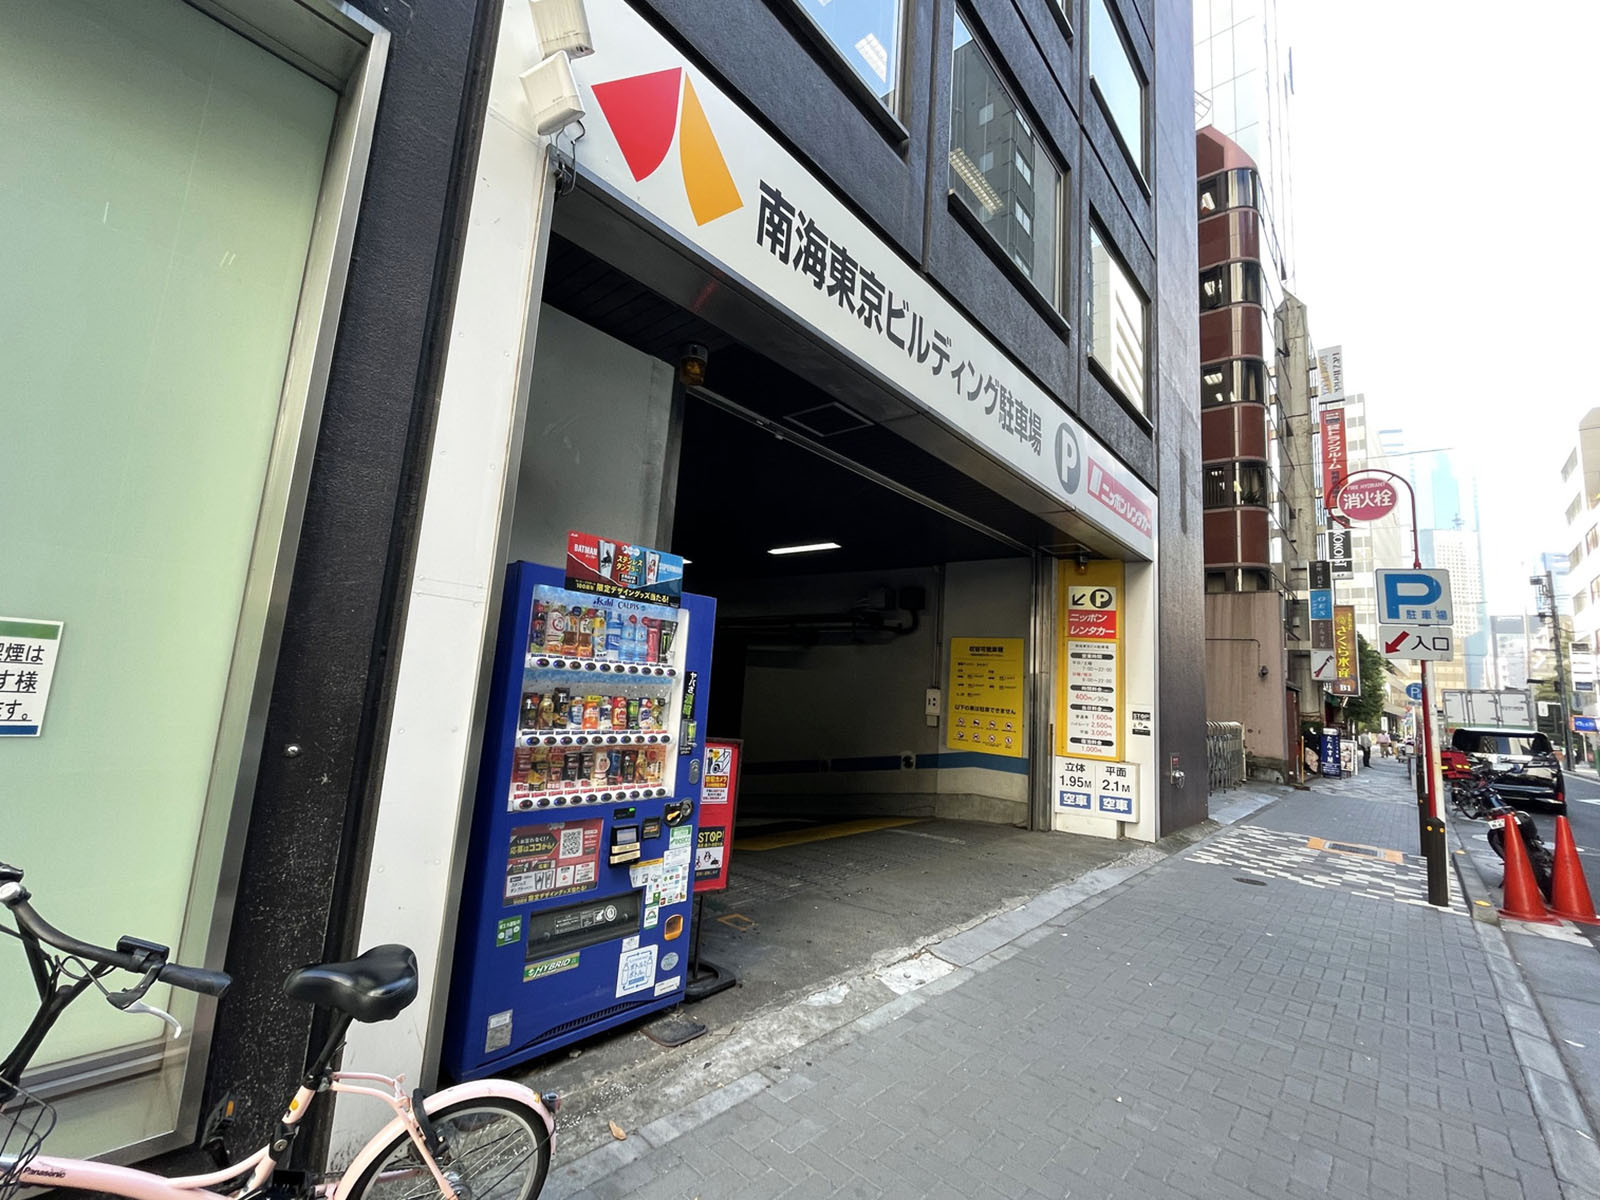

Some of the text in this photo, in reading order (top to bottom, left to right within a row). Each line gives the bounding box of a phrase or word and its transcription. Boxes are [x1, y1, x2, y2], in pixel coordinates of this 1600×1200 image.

[756, 178, 1042, 456] 南海東京ビルディング駐車場
[1343, 489, 1393, 510] 消火栓
[574, 543, 598, 556] BATMAN
[1384, 574, 1442, 619] P
[617, 601, 640, 611] CALPIS
[1069, 613, 1108, 623] ニッポン
[1406, 609, 1448, 620] 駐車場
[1070, 625, 1116, 636] レンタカー
[1411, 635, 1450, 651] 入口
[1340, 684, 1352, 692] B1
[0, 699, 29, 721] す。
[1065, 762, 1086, 773] 立体
[1105, 765, 1127, 777] 平面
[1063, 793, 1088, 807] 空車
[1102, 797, 1129, 812] 空車
[23, 1166, 66, 1178] Panasonic
